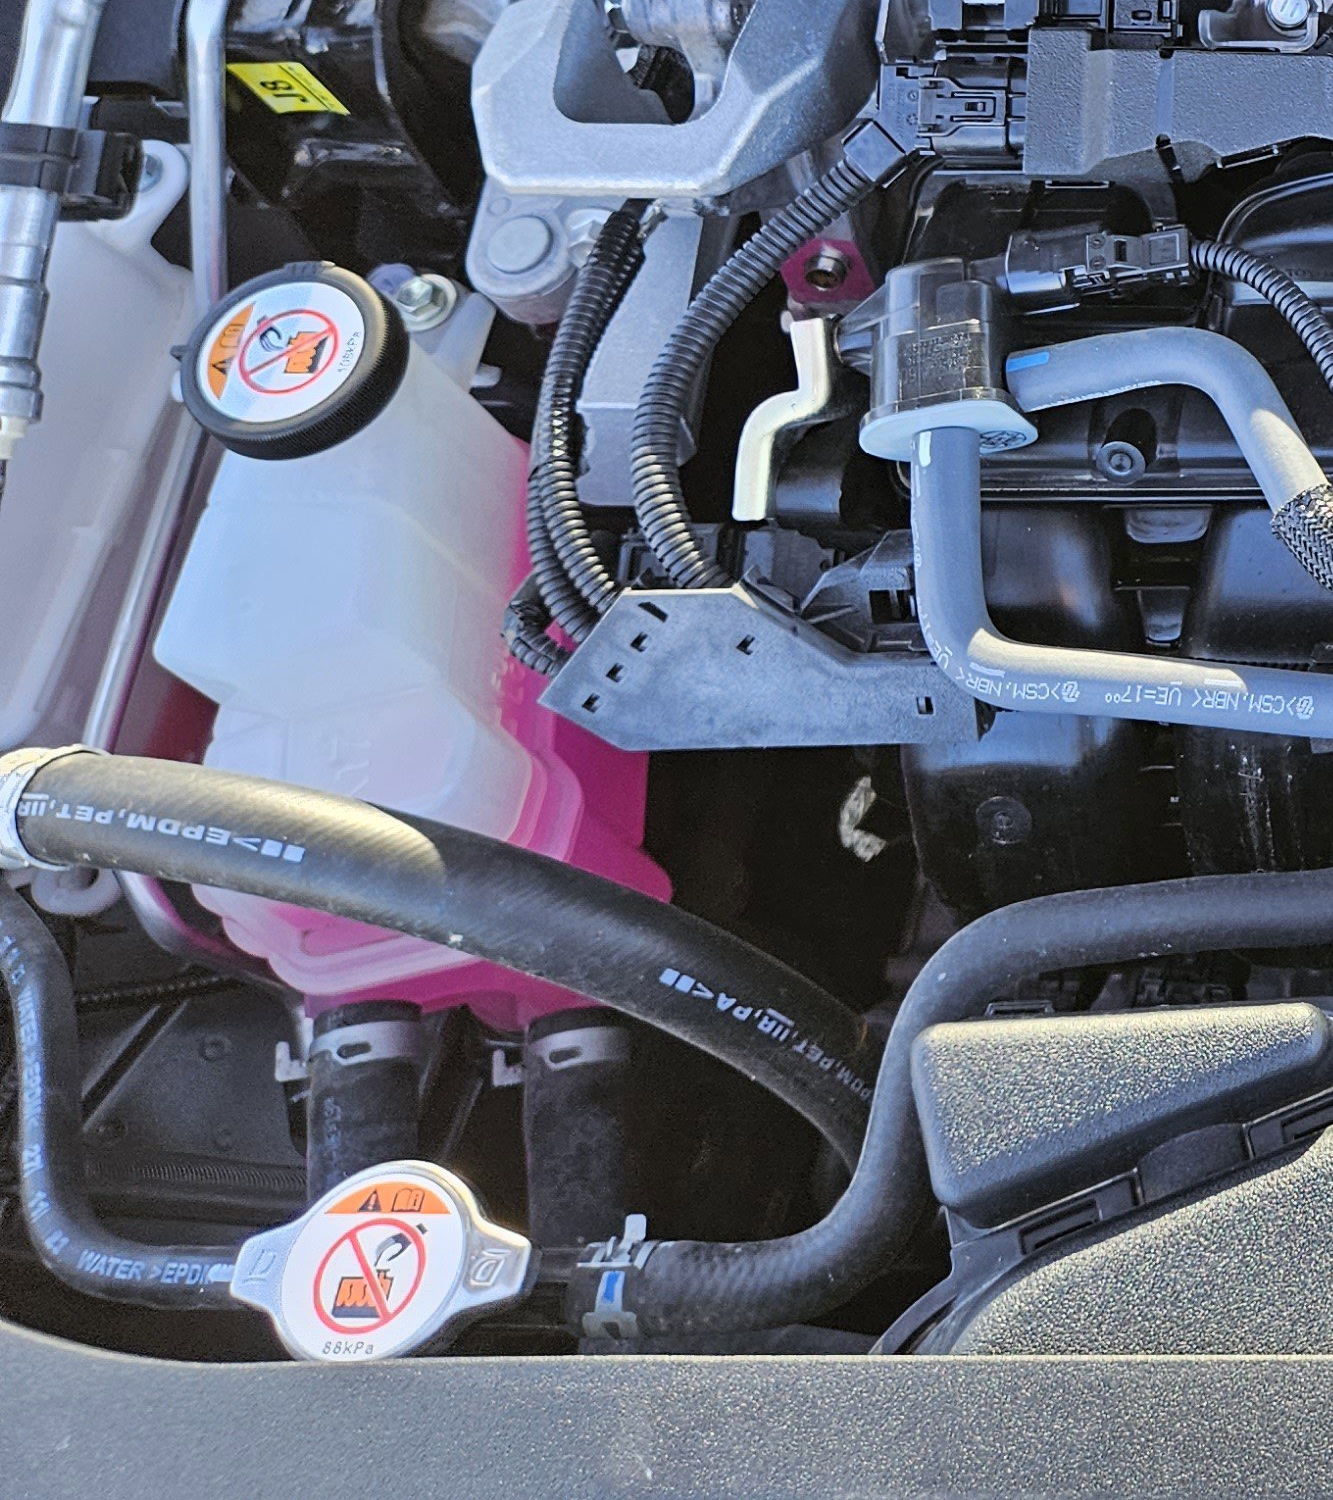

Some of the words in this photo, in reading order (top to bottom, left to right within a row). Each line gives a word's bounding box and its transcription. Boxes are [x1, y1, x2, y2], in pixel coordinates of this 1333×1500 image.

[691, 981, 872, 1101] PDM,PET,IIR,PA<
[77, 1249, 144, 1281] WATER
[322, 1341, 374, 1355] 88kPa
